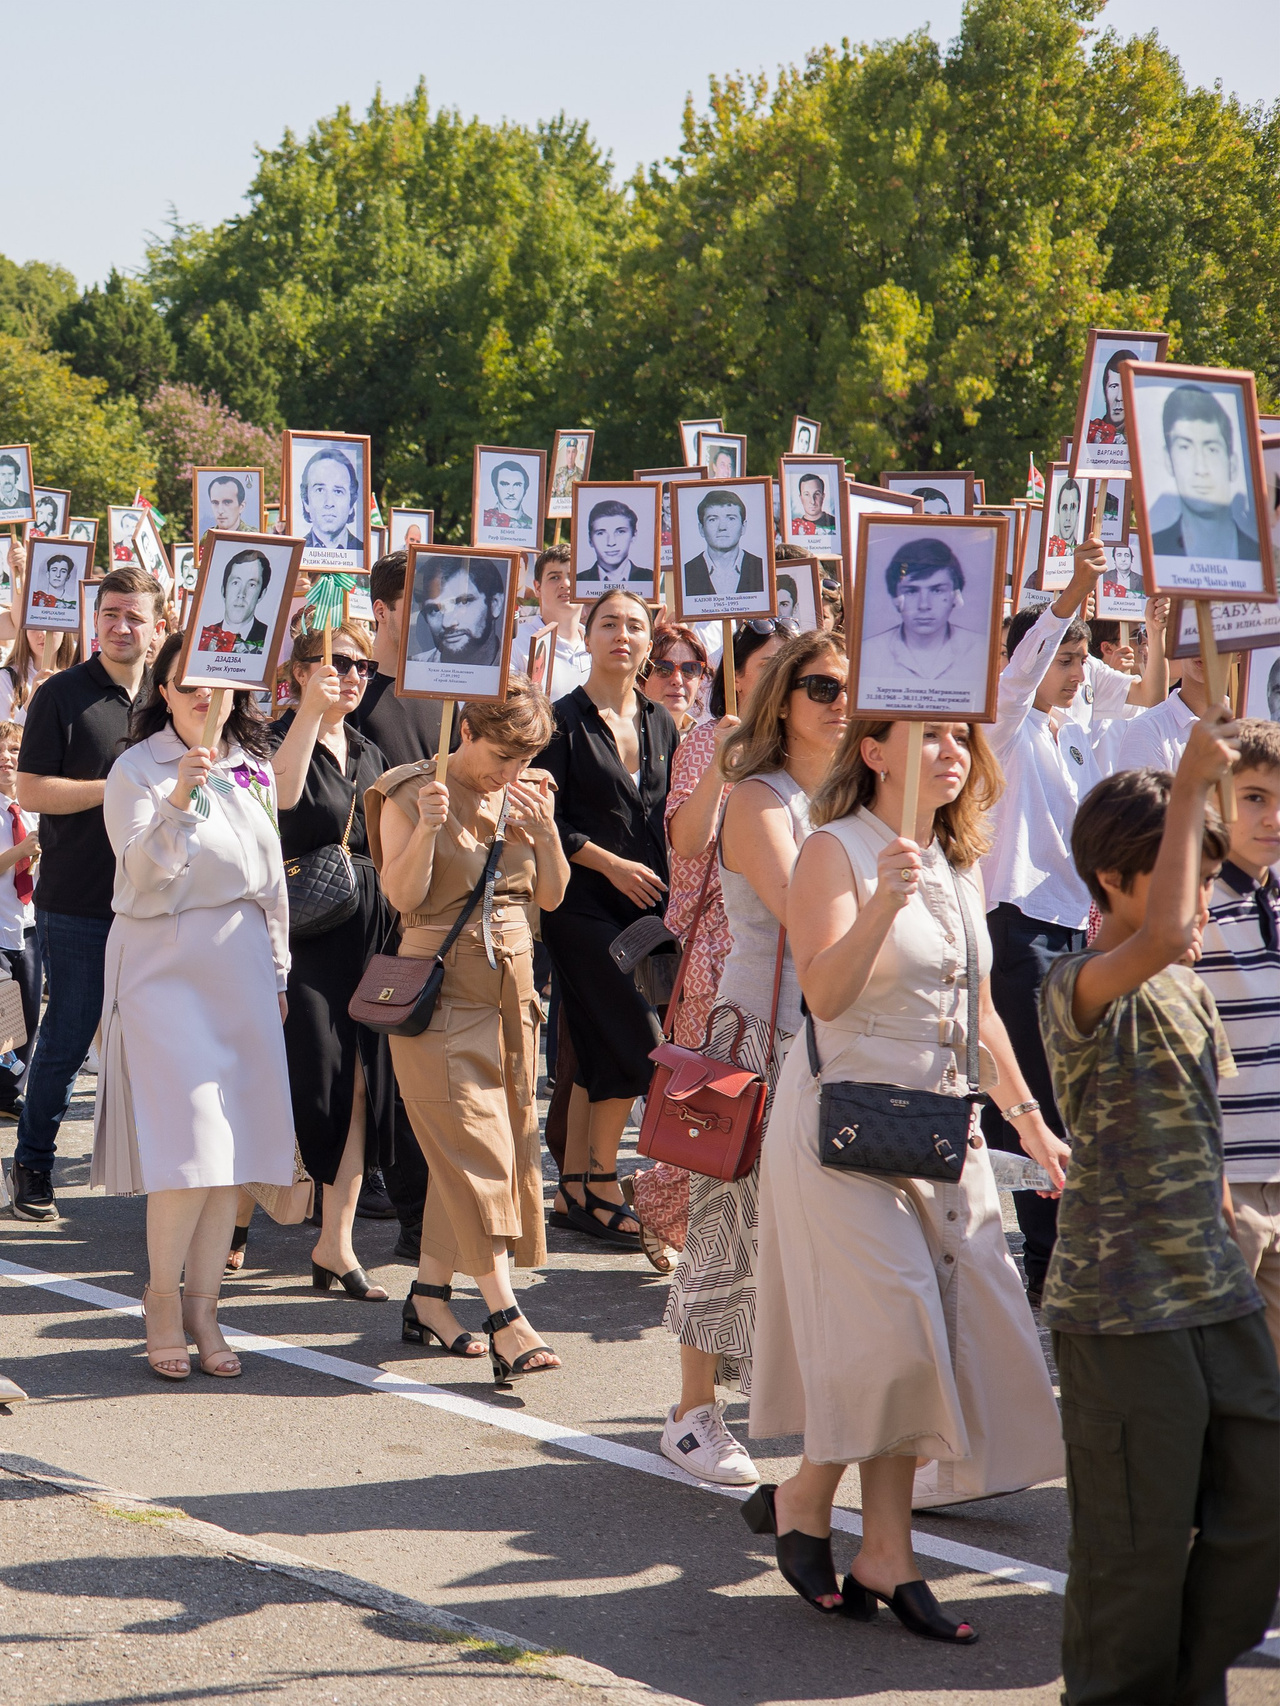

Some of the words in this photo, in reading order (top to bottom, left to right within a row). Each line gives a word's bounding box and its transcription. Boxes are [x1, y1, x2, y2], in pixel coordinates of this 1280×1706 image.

[1189, 563, 1228, 574] АЗЫНБА
[1025, 592, 1050, 601] Джопуа
[224, 665, 246, 673] Хутович
